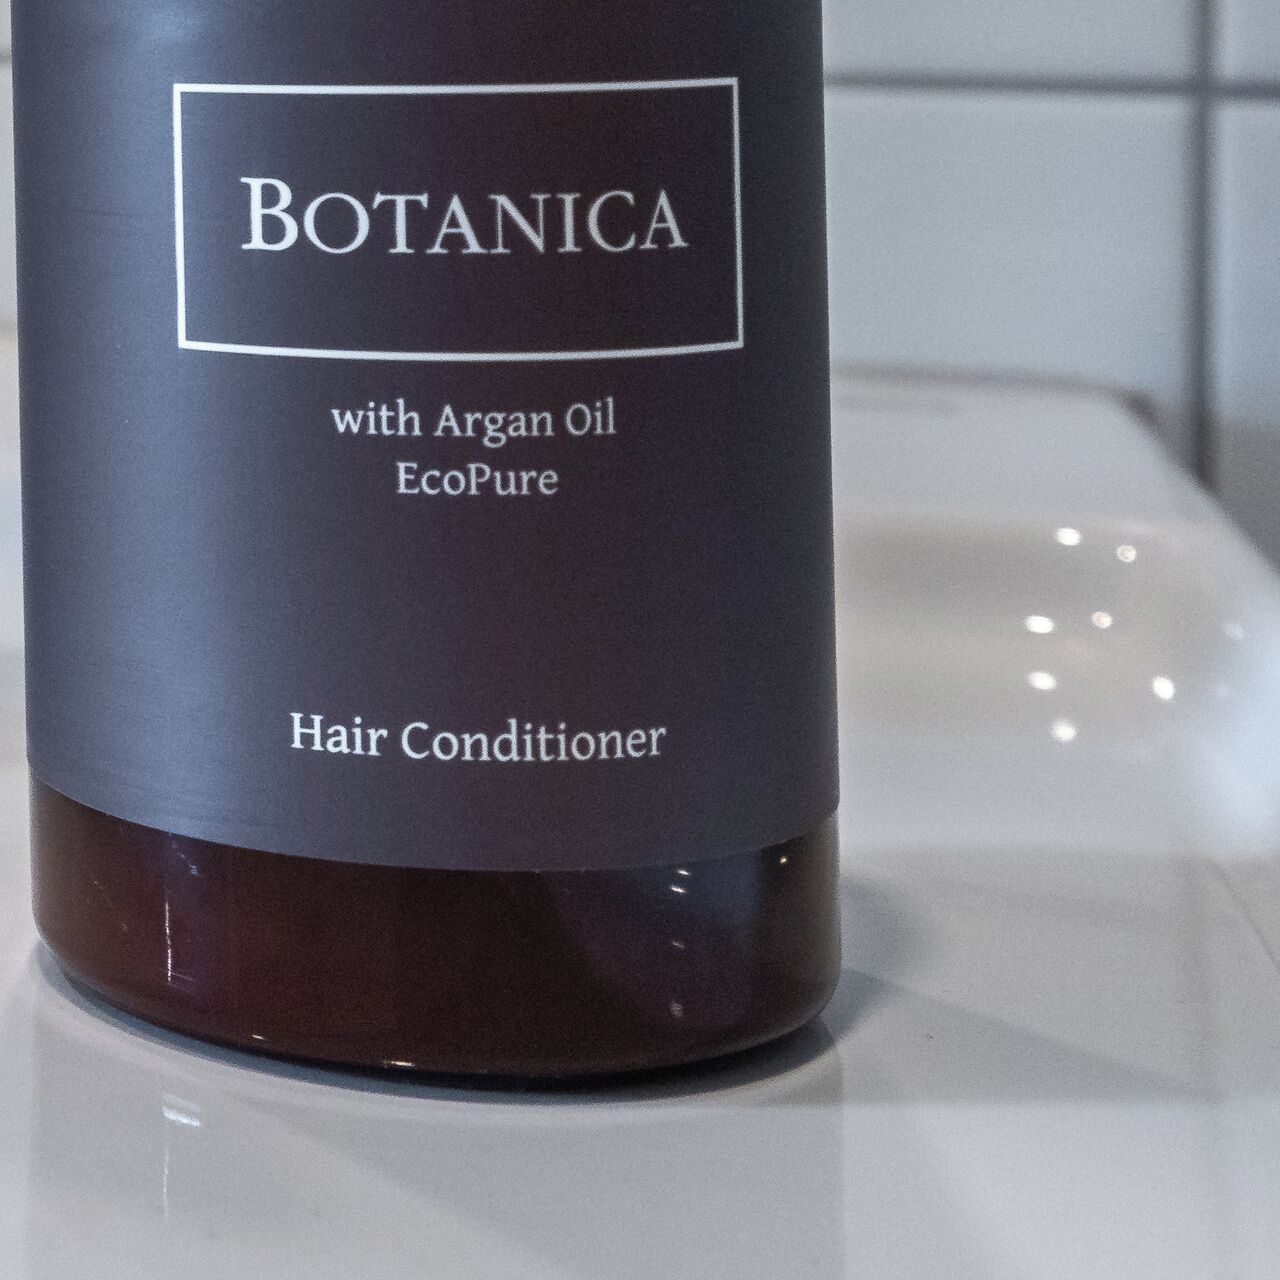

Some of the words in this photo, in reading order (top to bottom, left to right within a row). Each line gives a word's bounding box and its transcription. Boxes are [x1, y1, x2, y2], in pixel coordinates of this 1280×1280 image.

[330, 399, 422, 438] with
[432, 403, 555, 449] Argan
[565, 395, 617, 437] Oil
[395, 460, 559, 497] EcoPure
[288, 711, 389, 758] Hair
[399, 719, 668, 763] Conditioner
